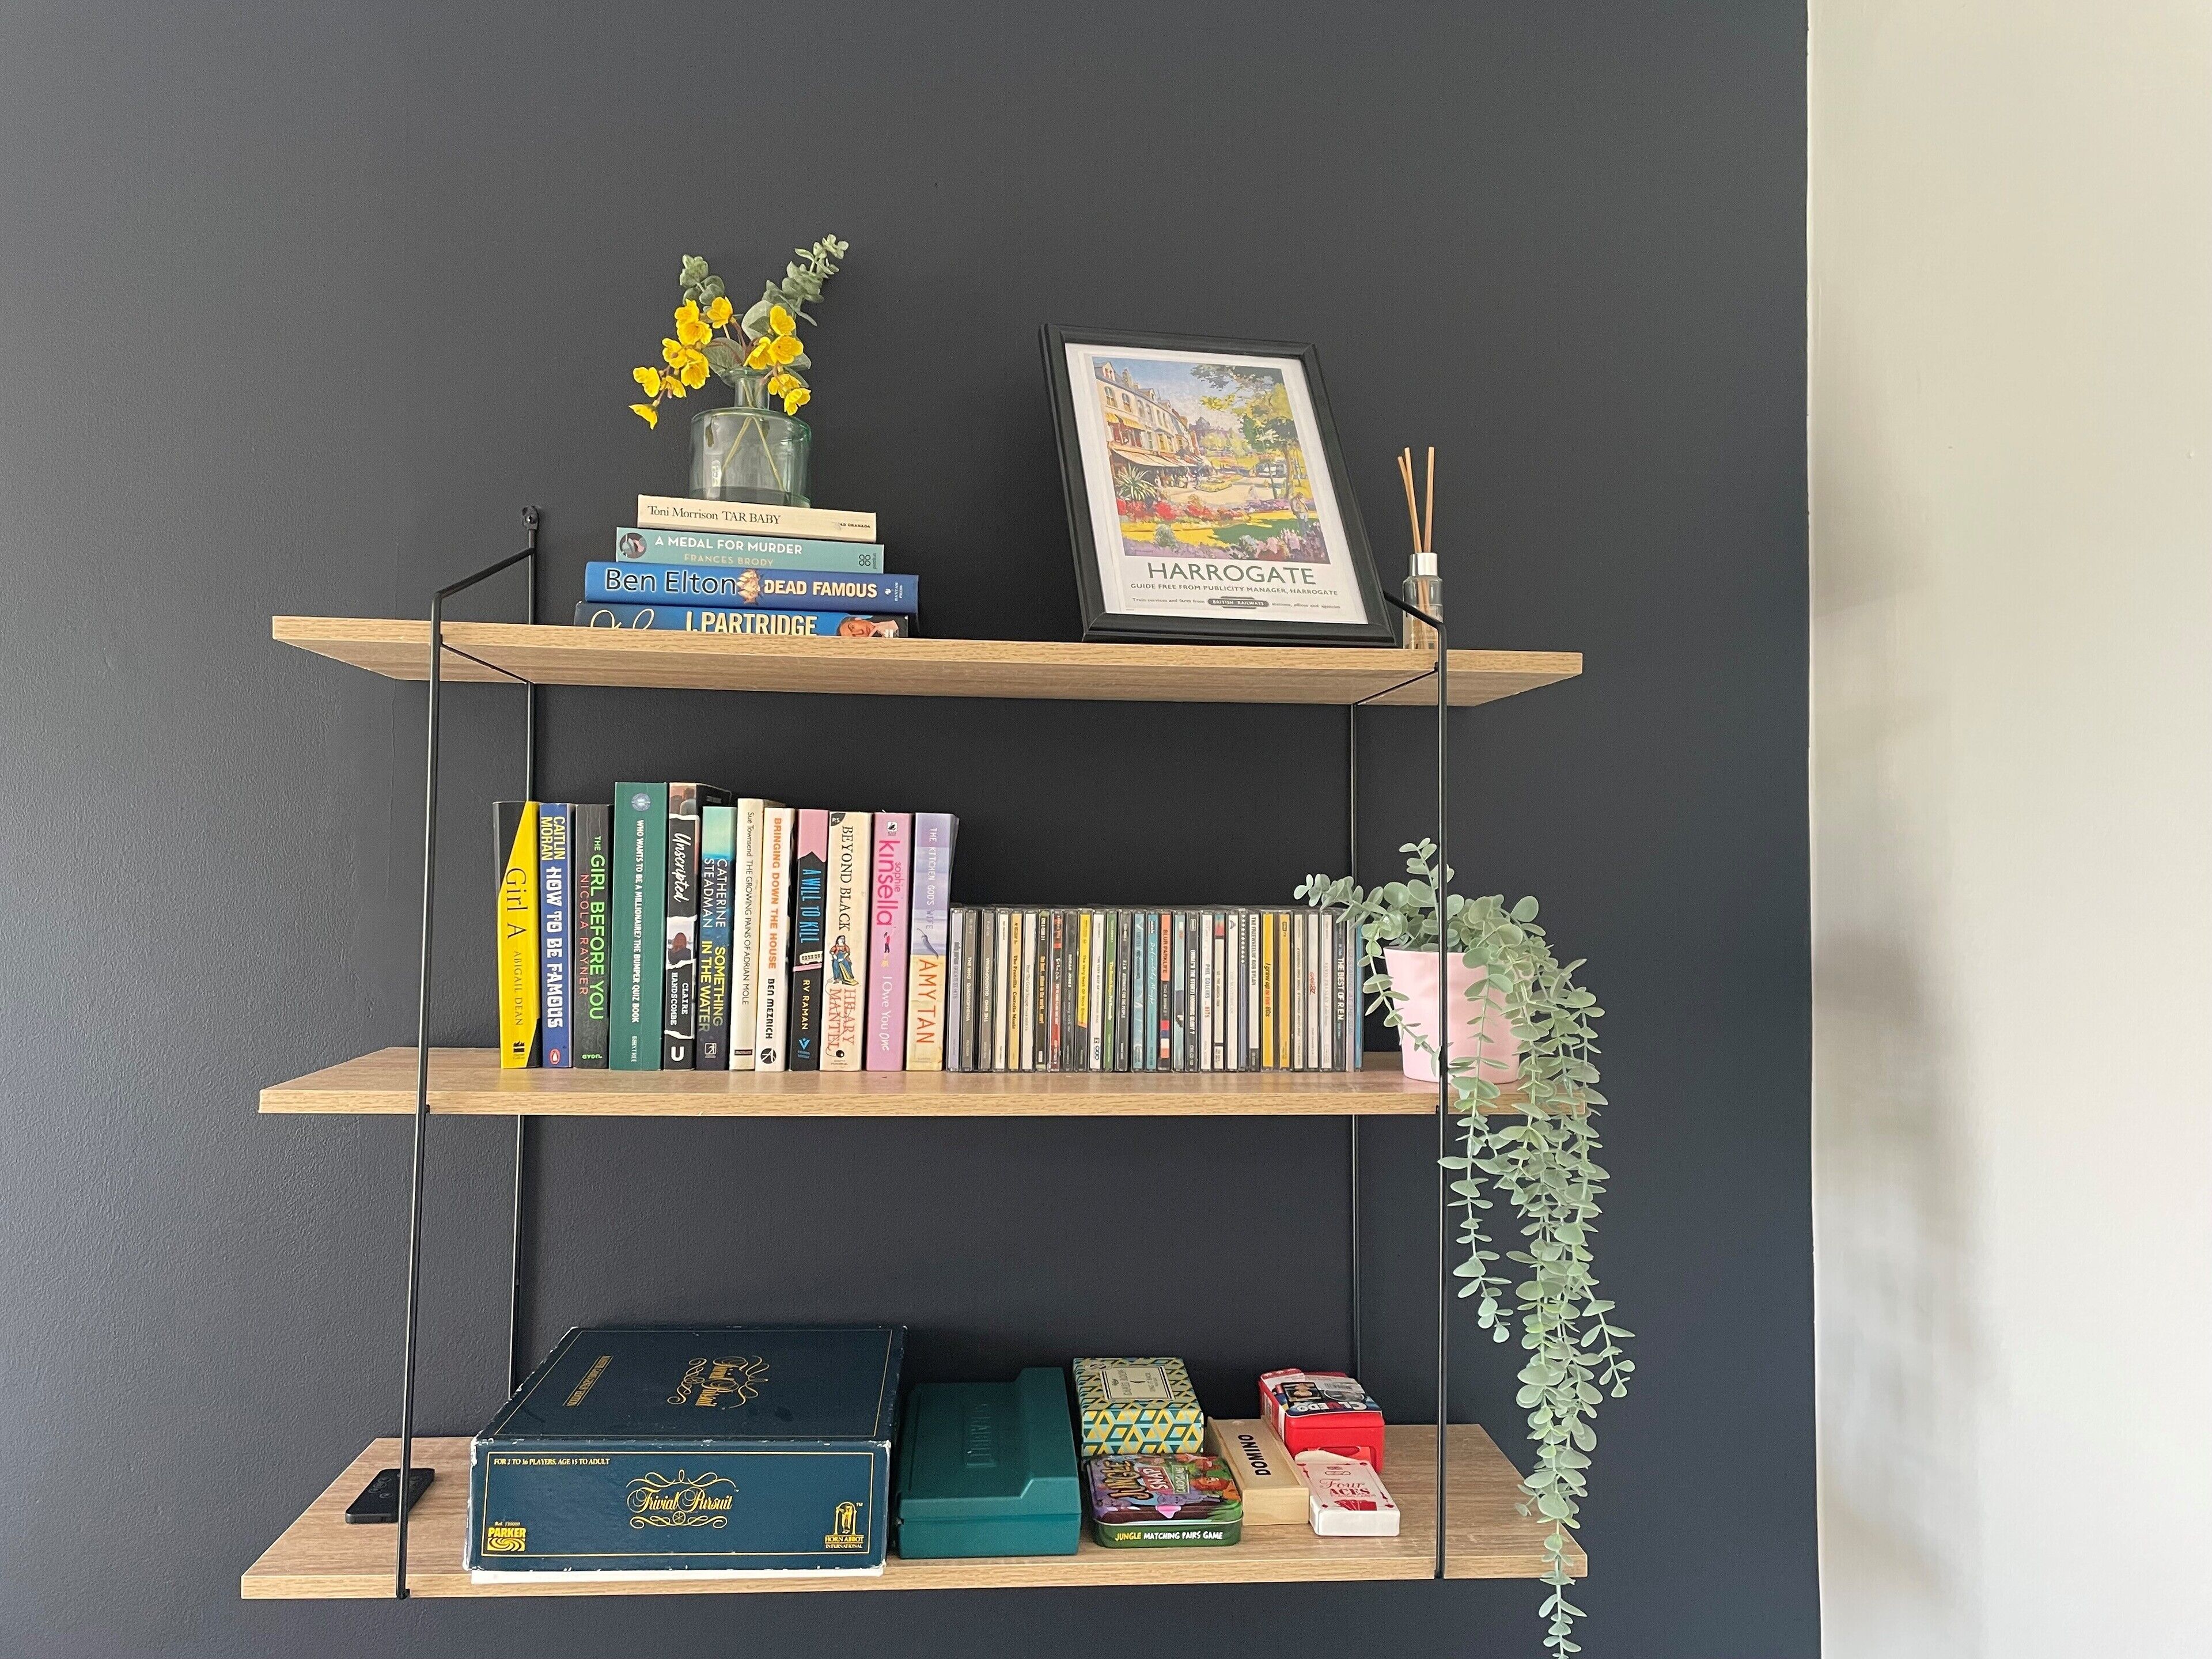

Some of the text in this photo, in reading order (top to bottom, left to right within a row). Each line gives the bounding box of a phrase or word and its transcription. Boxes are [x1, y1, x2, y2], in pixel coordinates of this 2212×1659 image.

[647, 505, 781, 524] Toni Morrison TAR BABY
[654, 536, 802, 555] A MEDAL FOR MURDER
[684, 552, 774, 567] FRANCES BRODY
[605, 568, 737, 596] Ben Elton
[1147, 562, 1317, 585] HARROGATE
[763, 579, 877, 599] DEAD FAMOUS
[1247, 586, 1289, 594] MANAGER,
[701, 611, 818, 637] PARTRIDGE
[635, 820, 645, 838] WHO
[747, 811, 755, 823] Sue
[540, 816, 553, 861] MORAN
[553, 816, 566, 860] CAITLIN
[746, 824, 754, 857] Townsend
[929, 828, 938, 842] THE
[635, 838, 645, 862] WANTS
[635, 863, 644, 873] TO
[673, 832, 692, 904] Unscripted
[892, 862, 904, 893] sophie
[927, 847, 936, 881] KITCHEN
[635, 873, 643, 884] BE
[801, 878, 821, 902] WILL
[838, 825, 854, 931] BEYOND BLACK
[876, 840, 900, 926] kinsella
[506, 868, 528, 940] Girl A
[702, 857, 714, 929] STEADMAN
[715, 858, 727, 927] CATHERINE
[745, 876, 753, 915] GROWING
[768, 817, 782, 969] BRINGING DOWN THE HOUSE
[633, 891, 643, 938] MILLIONAIRE?
[800, 906, 821, 917] TO
[926, 910, 934, 929] WIFE
[578, 874, 590, 995] NICOLA RAYNER
[588, 835, 605, 1020] THE GIRL BEFORE YOU
[744, 916, 752, 938] PAINS
[798, 921, 819, 944] KILL
[546, 866, 564, 1028] HOW TO BE FAMOUS
[633, 939, 642, 953] THE
[744, 939, 752, 950] OF
[632, 953, 642, 984] BUMPER
[743, 951, 751, 981] ADRIAN
[513, 950, 524, 1026] ABIGAIL DEAN
[631, 984, 641, 1002] QUIZ
[698, 941, 712, 1032] IN THE WATER
[712, 946, 726, 1027] SOMETHING
[917, 959, 938, 1001] AMY
[1264, 981, 1270, 989] up
[669, 972, 679, 1025] HANDSCOMBE
[681, 982, 689, 1015] CLAIRE
[742, 983, 750, 1005] MOLE
[801, 980, 810, 1030] RV RAMAN
[881, 981, 892, 1007] Owe
[1338, 991, 1344, 1001] OF
[631, 1002, 641, 1024] BOOK
[827, 988, 842, 1052] MANTEL
[842, 988, 856, 1046] HILARY
[880, 1010, 892, 1031] You
[916, 1005, 936, 1043] TAN
[1296, 1402, 1368, 1412] CLUEDO
[1237, 1434, 1272, 1476] DOMINO
[1103, 1459, 1150, 1500] JUNGLE
[1142, 1468, 1169, 1490] SNAP
[1319, 1478, 1365, 1489] Four
[627, 1486, 733, 1513] Trivial Pursuit
[487, 1527, 527, 1538] PARKER
[1115, 1530, 1224, 1541] JUNGLE MATCHING PAIRS GAME
